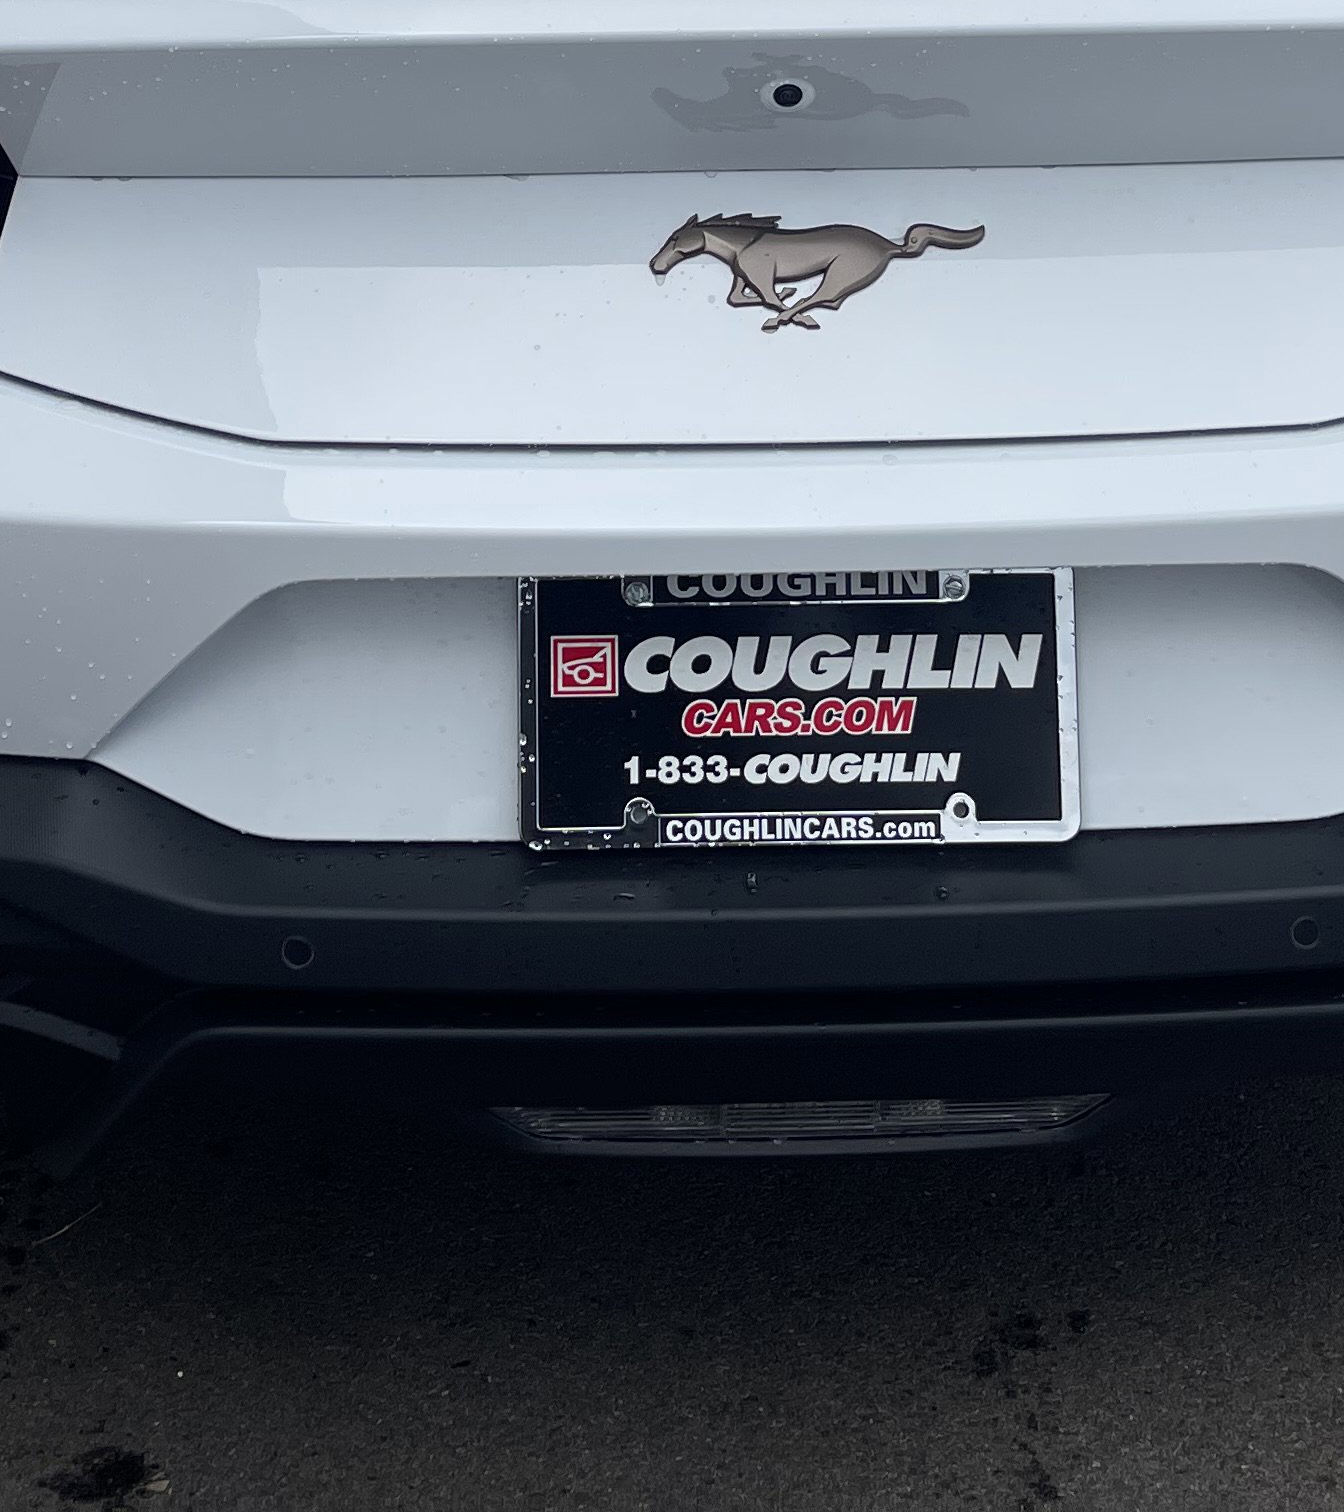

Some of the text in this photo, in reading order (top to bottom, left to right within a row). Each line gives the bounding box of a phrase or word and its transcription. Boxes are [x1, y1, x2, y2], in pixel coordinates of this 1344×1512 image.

[666, 570, 927, 599] COUGHLIN
[623, 633, 1043, 693] COUGHLIN
[681, 696, 918, 737] CARS.COM
[623, 752, 961, 785] 1-833-COUGHLIN
[666, 815, 936, 842] COUGHLINCARS.com
